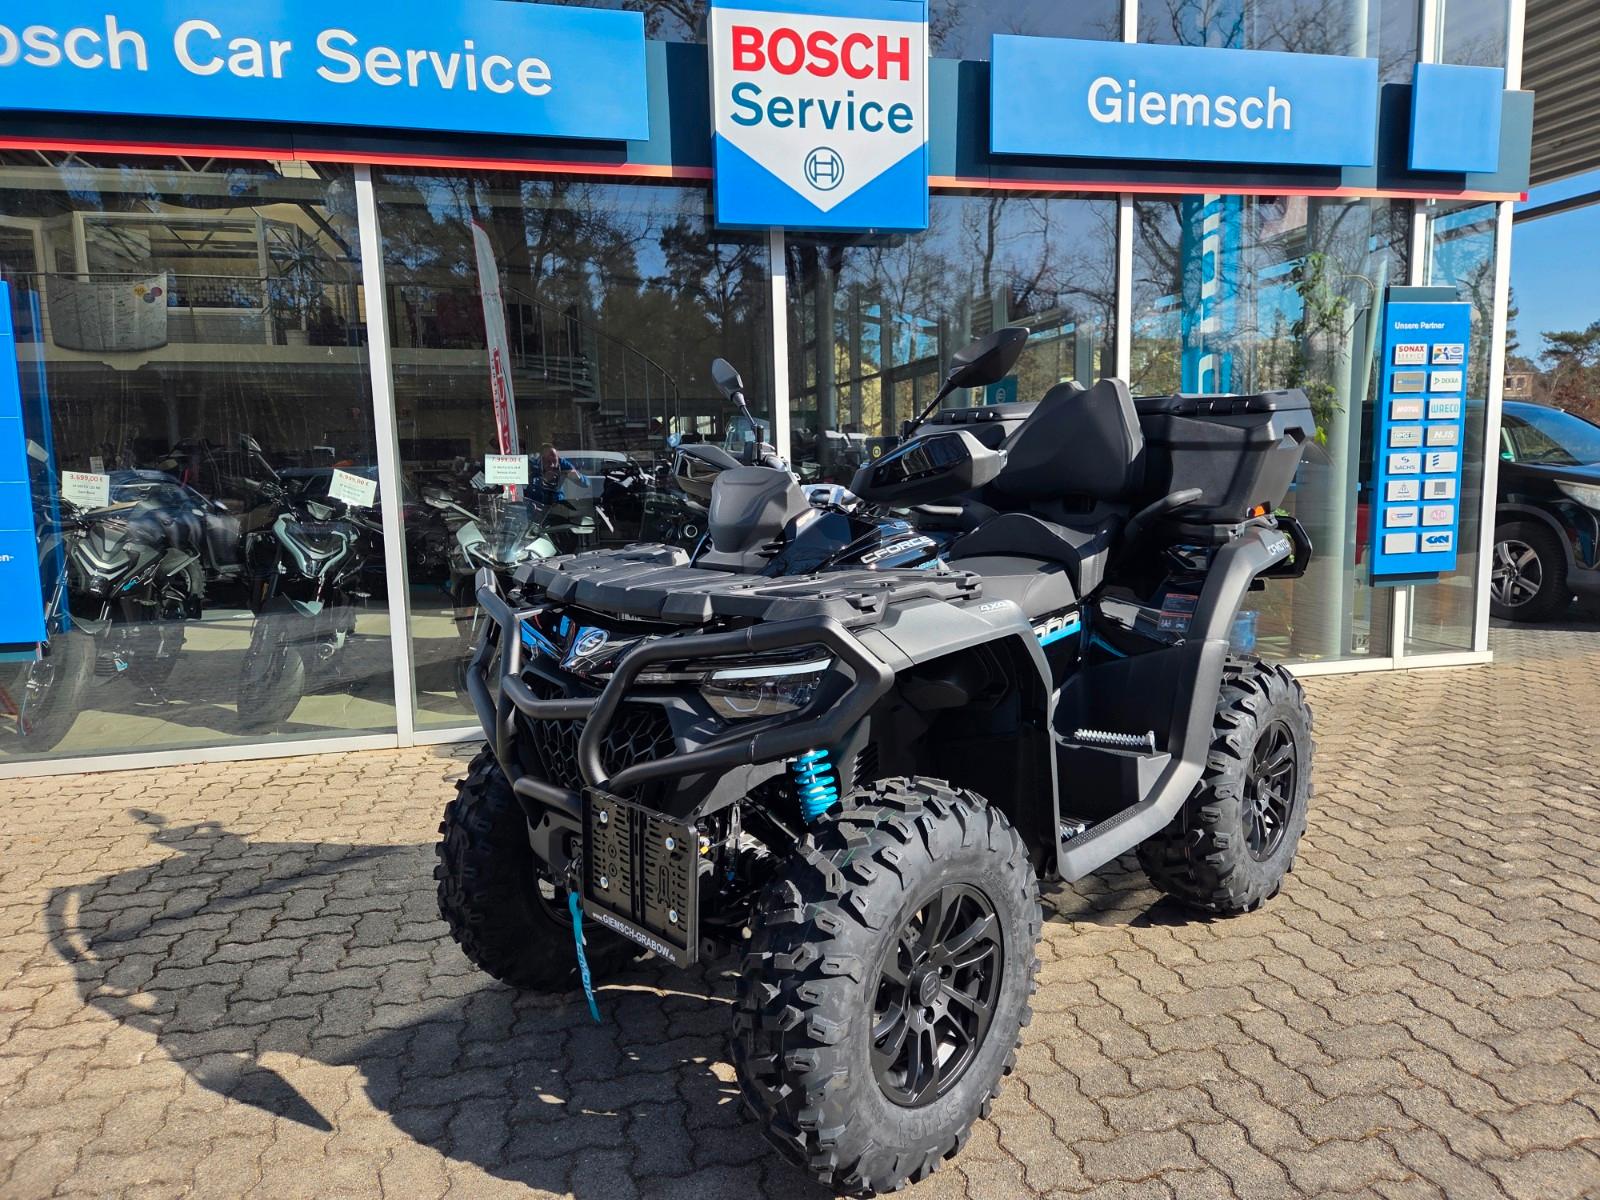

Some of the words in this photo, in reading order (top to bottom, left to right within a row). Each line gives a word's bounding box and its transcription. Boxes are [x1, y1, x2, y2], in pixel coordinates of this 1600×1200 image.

[174, 20, 292, 79] Car
[316, 28, 552, 96] Service
[731, 25, 910, 81] BOSCH
[730, 81, 914, 134] Service
[1088, 76, 1292, 130] Giemsch
[1394, 321, 1419, 330] Unsere
[1420, 321, 1446, 330] Partner
[1398, 345, 1425, 353] SONAX
[860, 535, 937, 564] CFORCE
